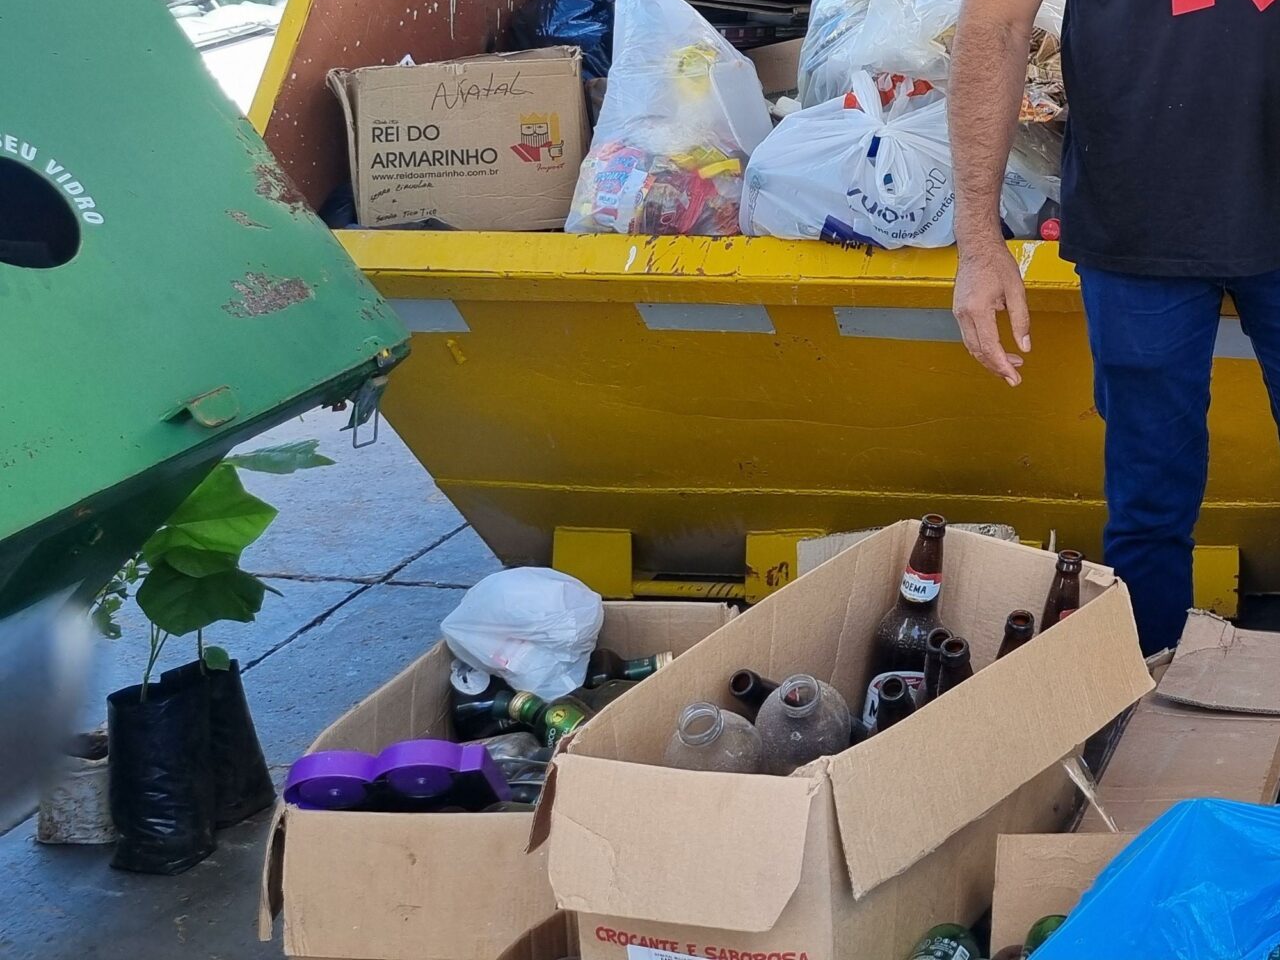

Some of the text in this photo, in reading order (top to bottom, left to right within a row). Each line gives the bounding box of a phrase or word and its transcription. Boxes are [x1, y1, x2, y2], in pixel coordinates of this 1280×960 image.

[372, 124, 440, 143] REI DO
[370, 147, 498, 169] ARMARINHO
[372, 168, 499, 180] www.reidoarmarinho.com.br
[45, 159, 104, 224] VIDRO
[595, 926, 679, 952] CROCANTE
[687, 944, 697, 957] E
